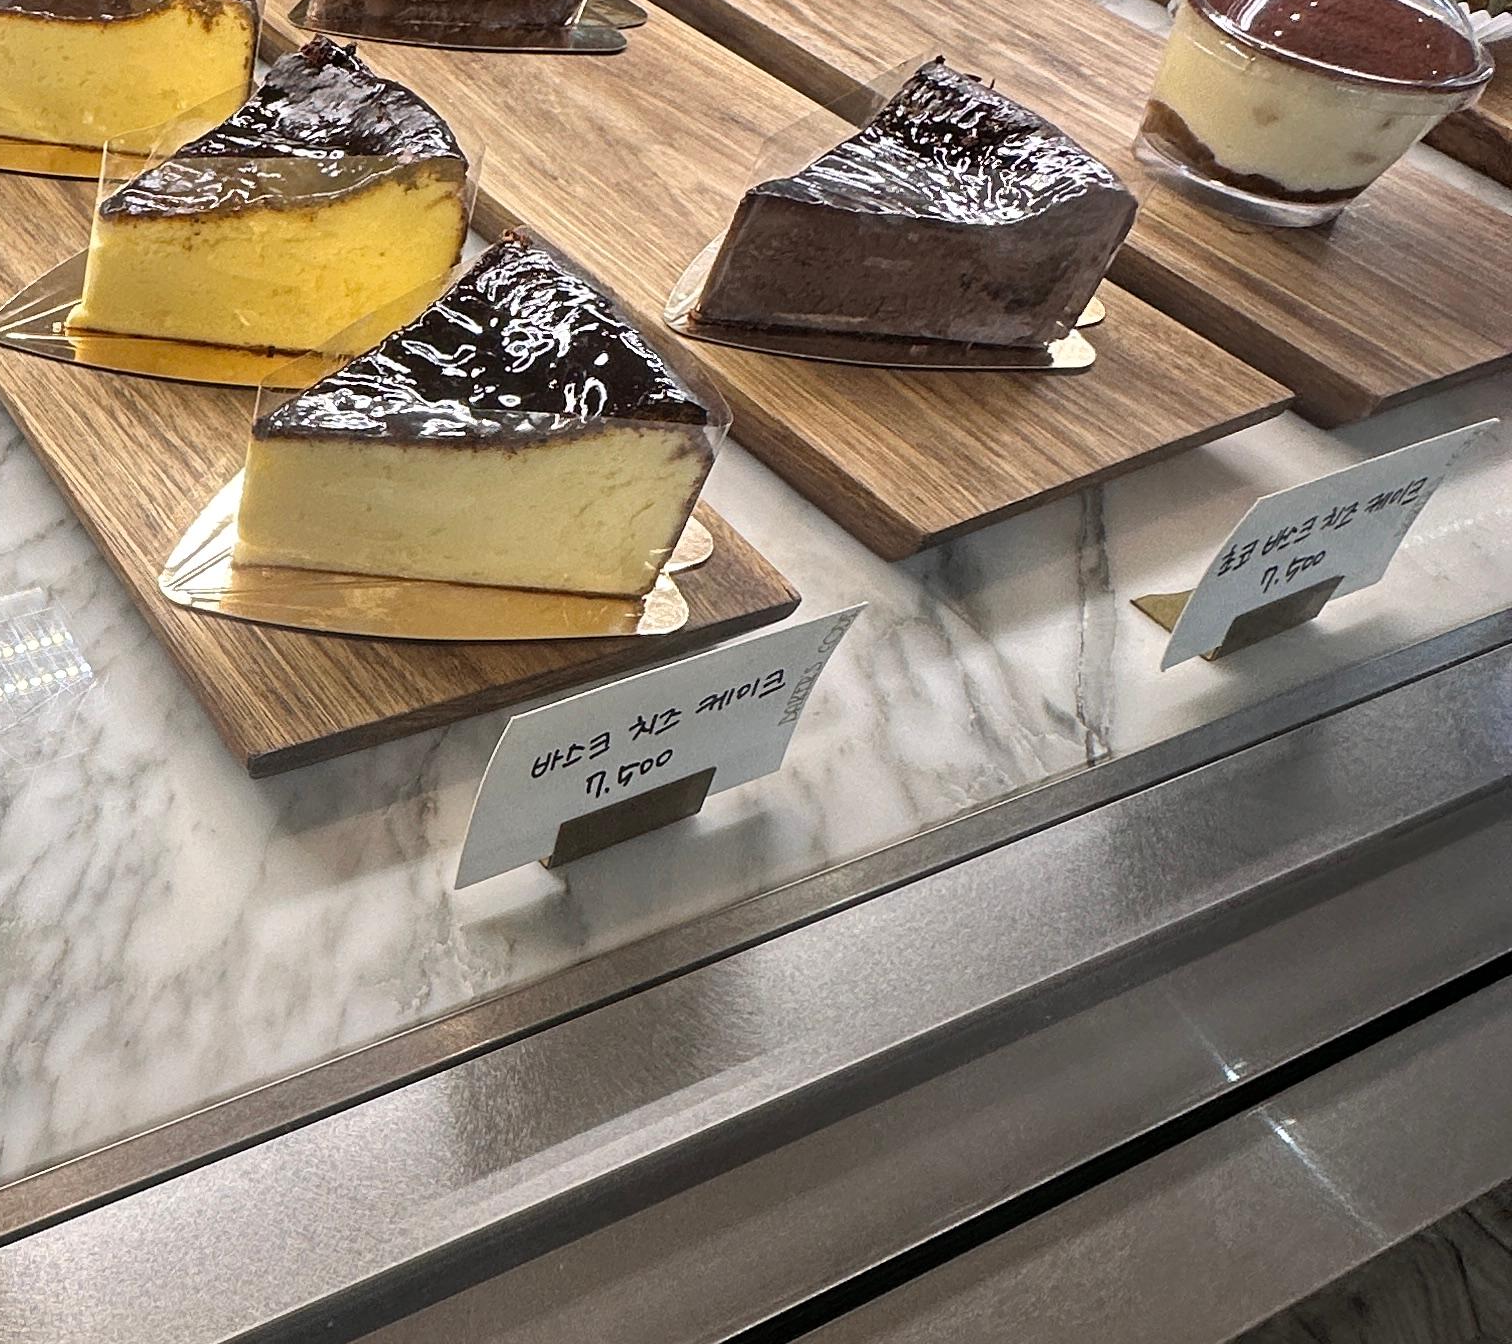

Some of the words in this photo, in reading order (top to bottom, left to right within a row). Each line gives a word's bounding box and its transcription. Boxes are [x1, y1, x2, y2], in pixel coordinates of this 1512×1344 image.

[1217, 539, 1260, 577] 초코
[1261, 515, 1319, 557] 바스크
[1320, 500, 1359, 530] 치즈
[1364, 476, 1429, 513] 케이크
[530, 731, 611, 779] 바스크
[628, 707, 683, 741] 치즈
[695, 668, 786, 714] 케이크
